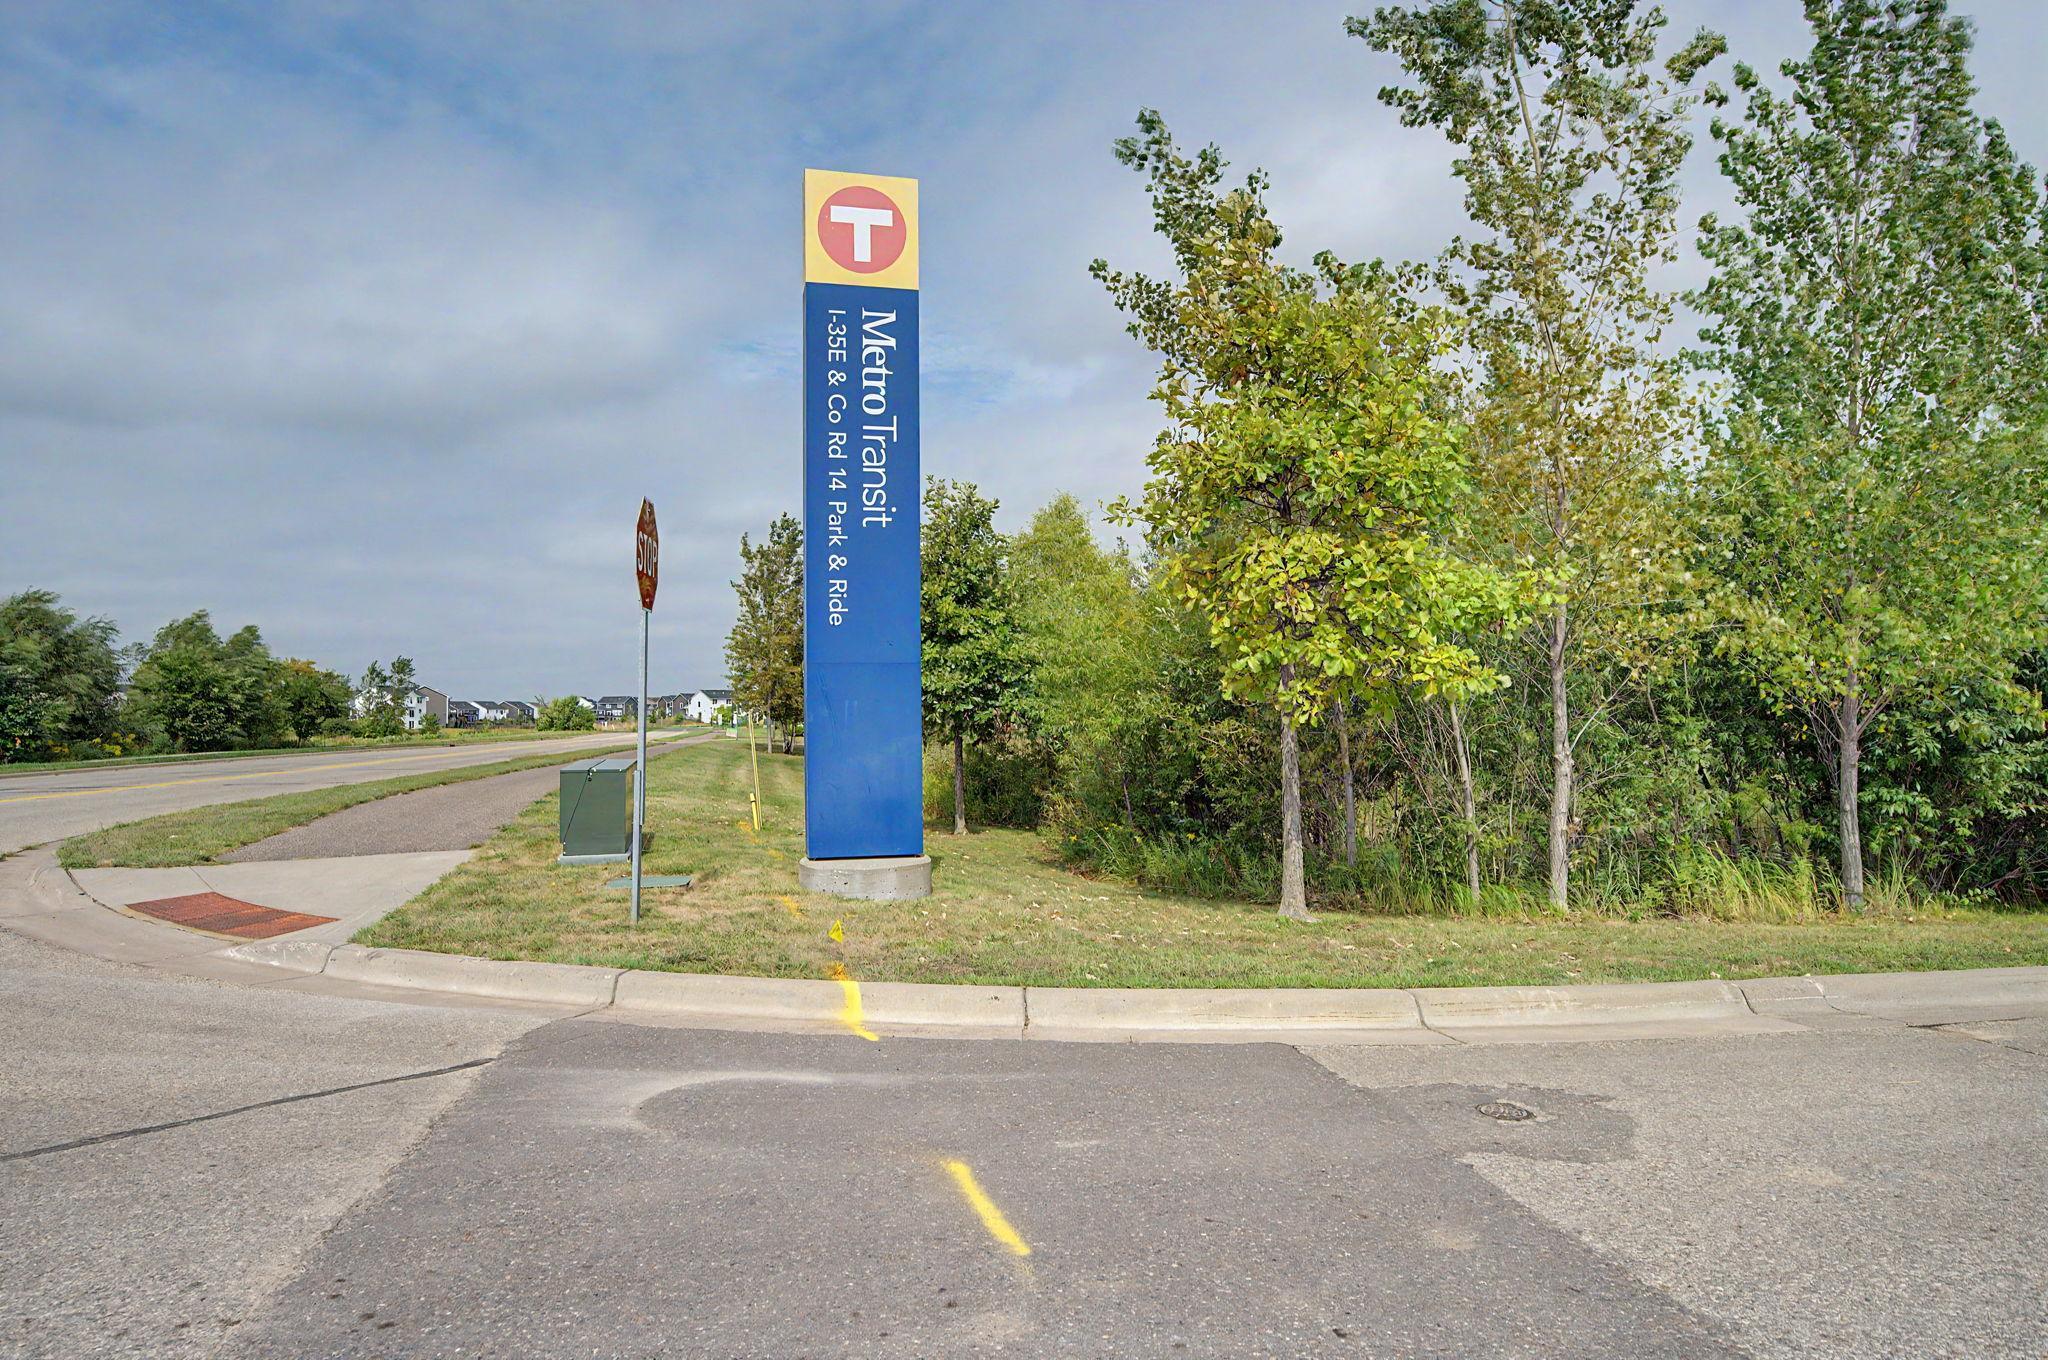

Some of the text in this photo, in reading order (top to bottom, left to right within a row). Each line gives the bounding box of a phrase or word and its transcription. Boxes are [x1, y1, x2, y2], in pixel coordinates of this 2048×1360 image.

[830, 205, 893, 262] T
[827, 309, 849, 626] I-35E & Co Rd 14 Park & Ride
[636, 530, 659, 578] STOP
